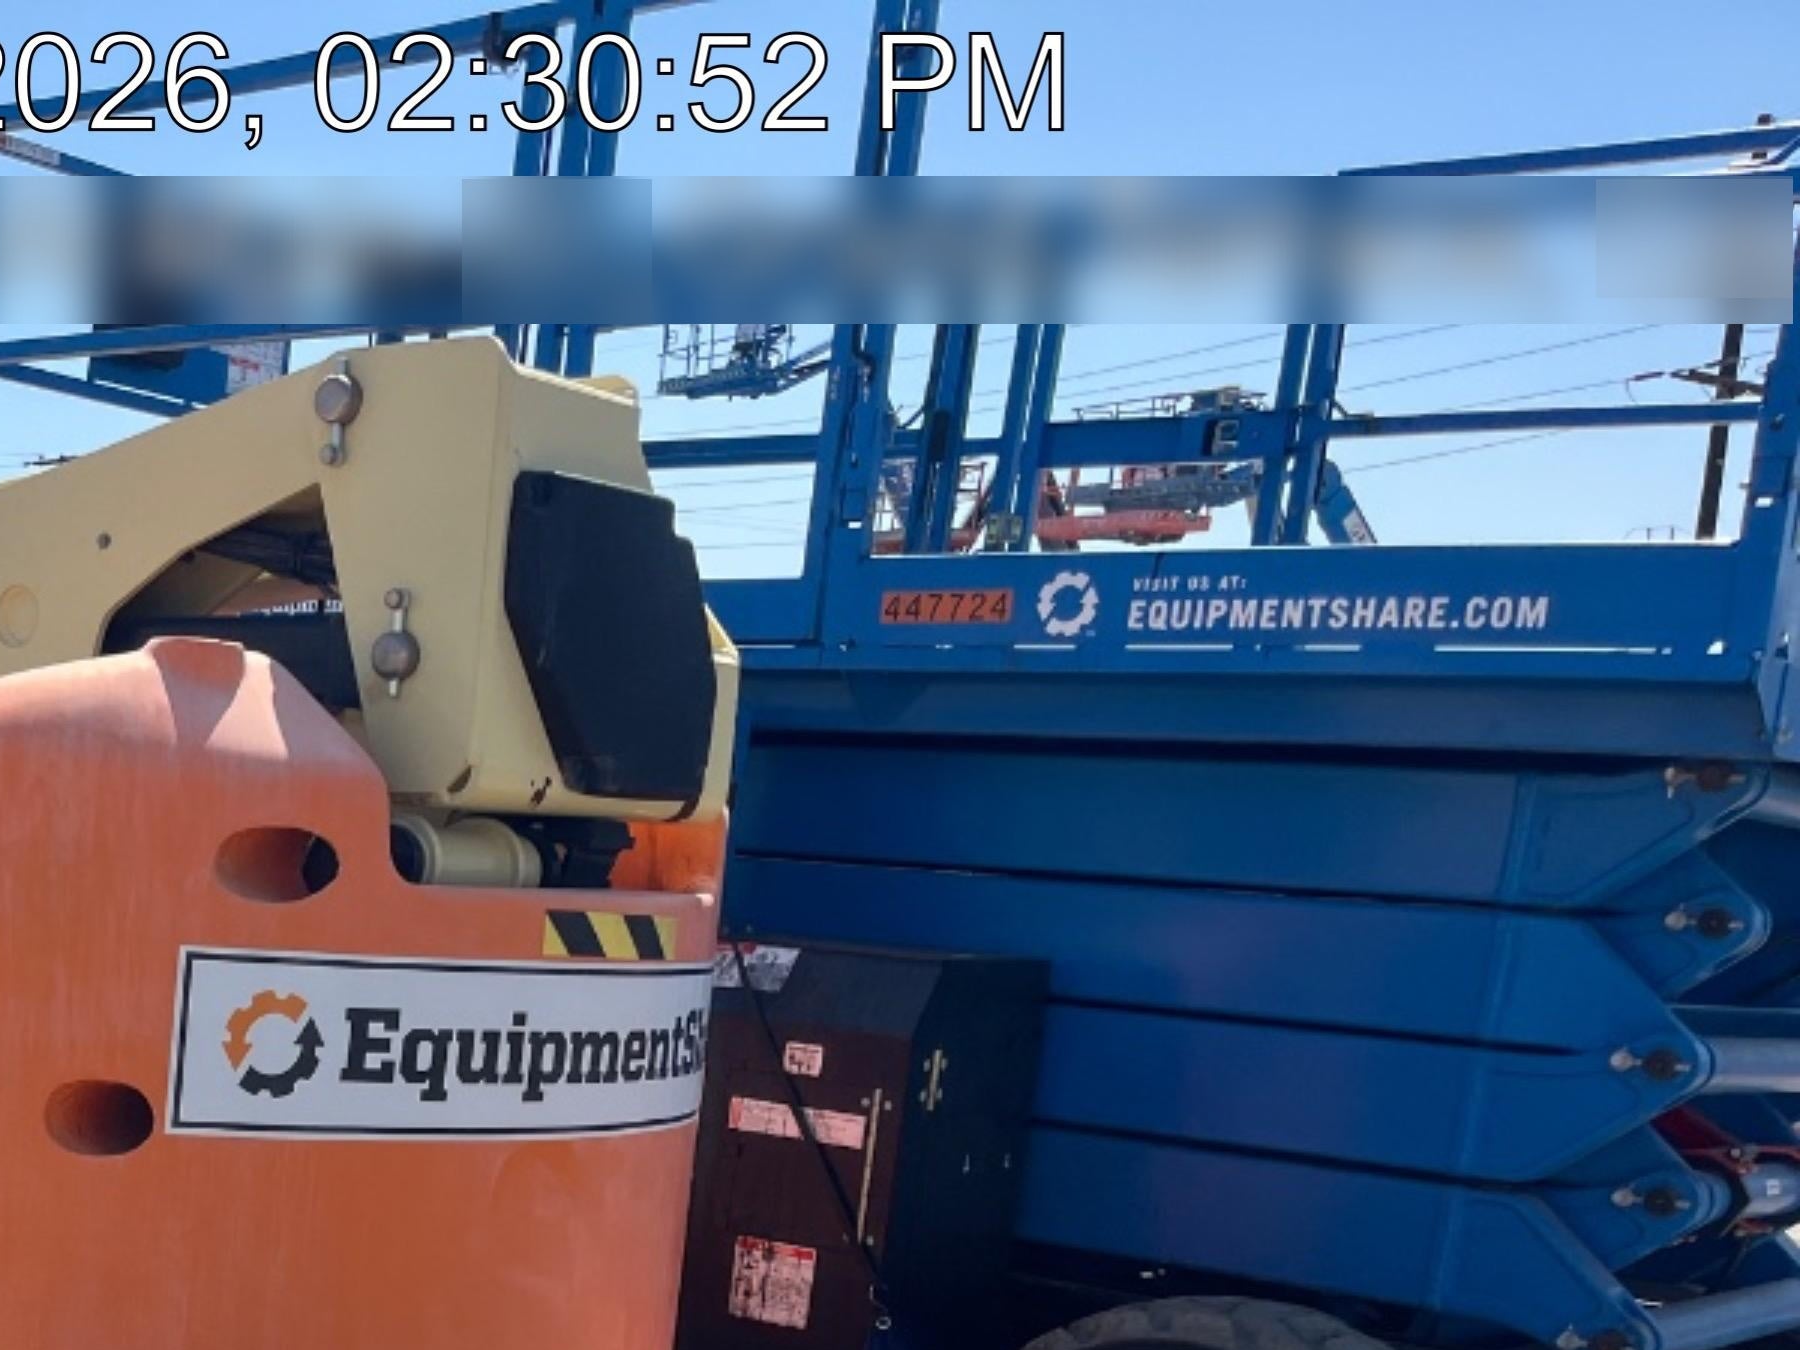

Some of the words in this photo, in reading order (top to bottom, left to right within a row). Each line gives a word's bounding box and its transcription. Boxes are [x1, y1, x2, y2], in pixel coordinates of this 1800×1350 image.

[1133, 575, 1180, 592] VISIT
[1187, 576, 1210, 592] US
[1218, 575, 1246, 591] AT:
[884, 592, 1008, 622] 447724
[1128, 596, 1549, 630] EQUIPMENTSHARE.COM
